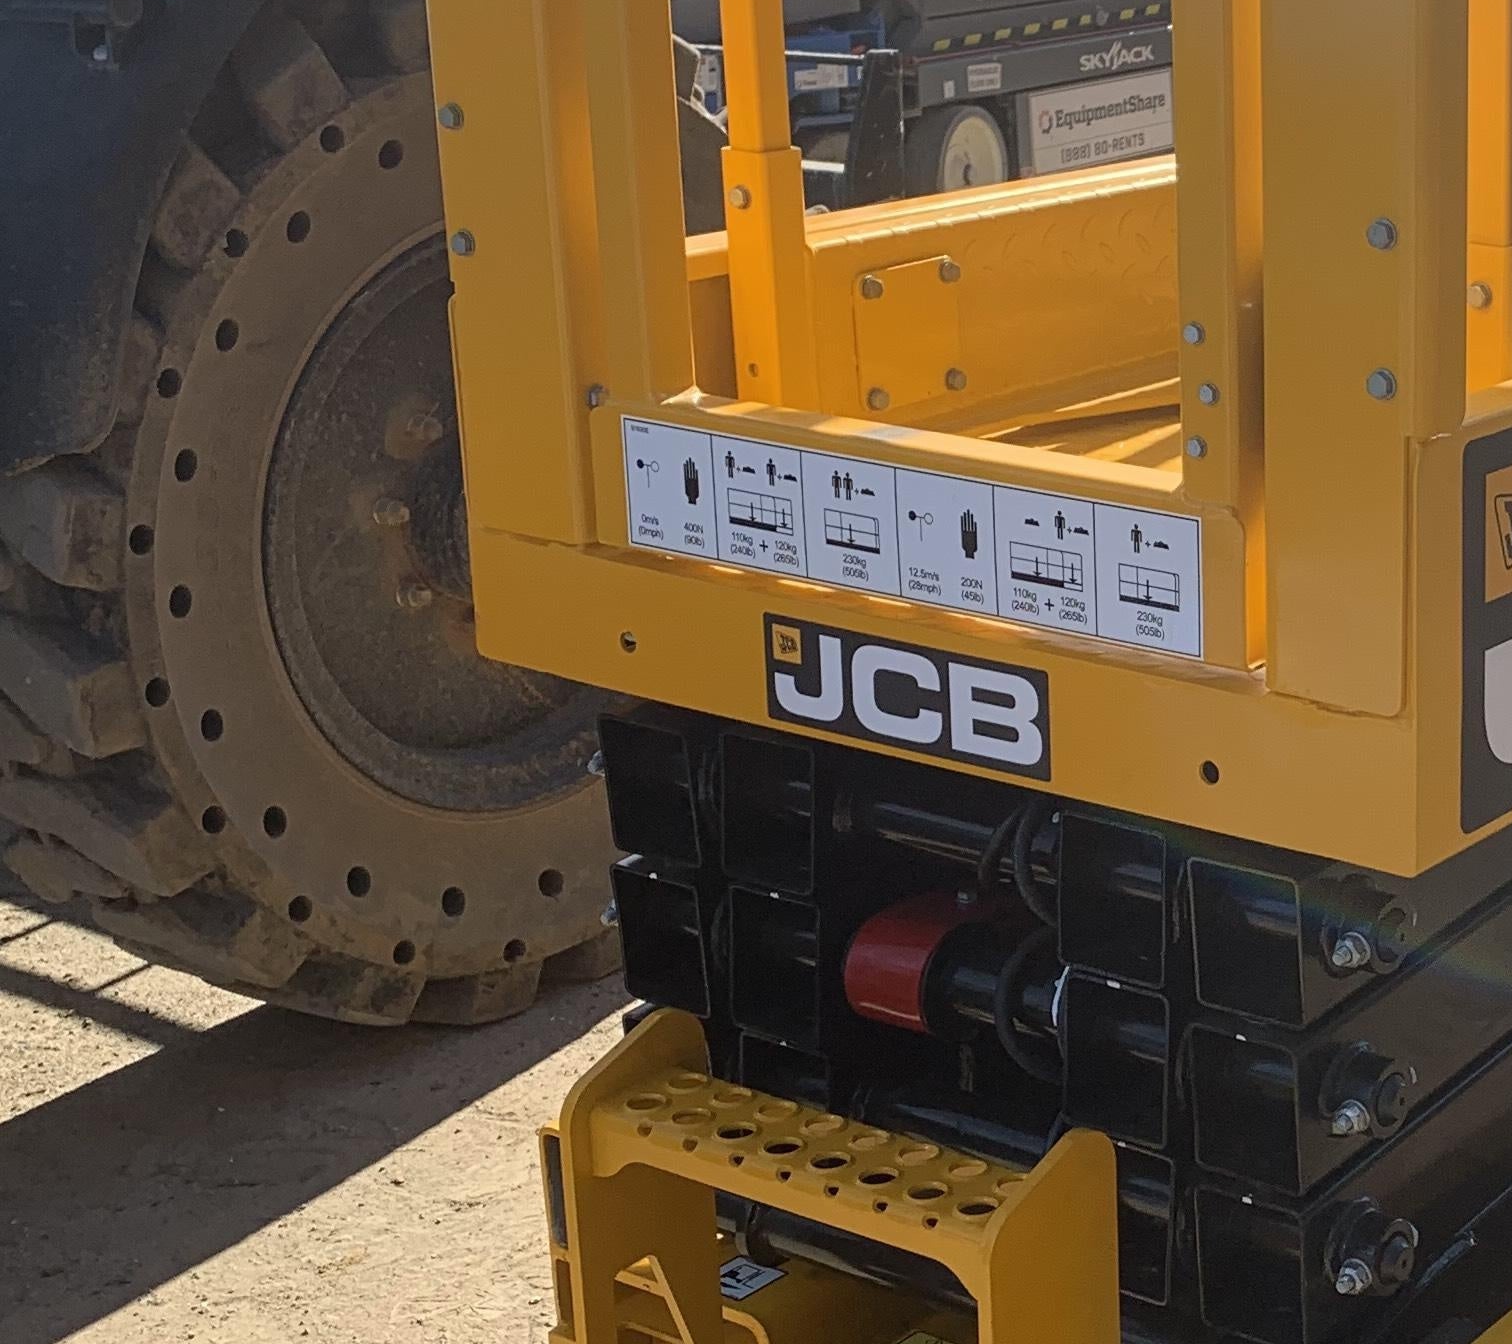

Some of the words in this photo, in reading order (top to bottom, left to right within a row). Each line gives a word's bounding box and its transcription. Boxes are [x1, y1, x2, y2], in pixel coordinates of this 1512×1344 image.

[1079, 40, 1154, 71] SKYJACK
[1054, 91, 1166, 129] EquipmentShare
[641, 513, 659, 526] 0m/s
[638, 525, 664, 541] (0mph)
[683, 522, 704, 535] 400N
[684, 534, 705, 549] (90lb)
[731, 531, 753, 546] 110kg
[774, 539, 797, 556] 120kg
[730, 543, 756, 559] (240lb)
[773, 552, 799, 569] (265lb)
[842, 553, 867, 569] 230kg
[842, 566, 869, 582] (505lb)
[908, 567, 940, 582] 12.5m/s
[908, 580, 942, 597] (28mph)
[960, 577, 983, 590] 200N
[961, 590, 985, 605] (45lb)
[1013, 587, 1037, 603] 110kg
[1060, 596, 1085, 612] 120kg
[1011, 600, 1040, 616] (240lb)
[1059, 609, 1088, 625] (265lb)
[1137, 611, 1163, 627] 230kg
[1135, 625, 1165, 641] (505lb)
[776, 631, 799, 655] JCB
[774, 634, 1043, 766] JCB
